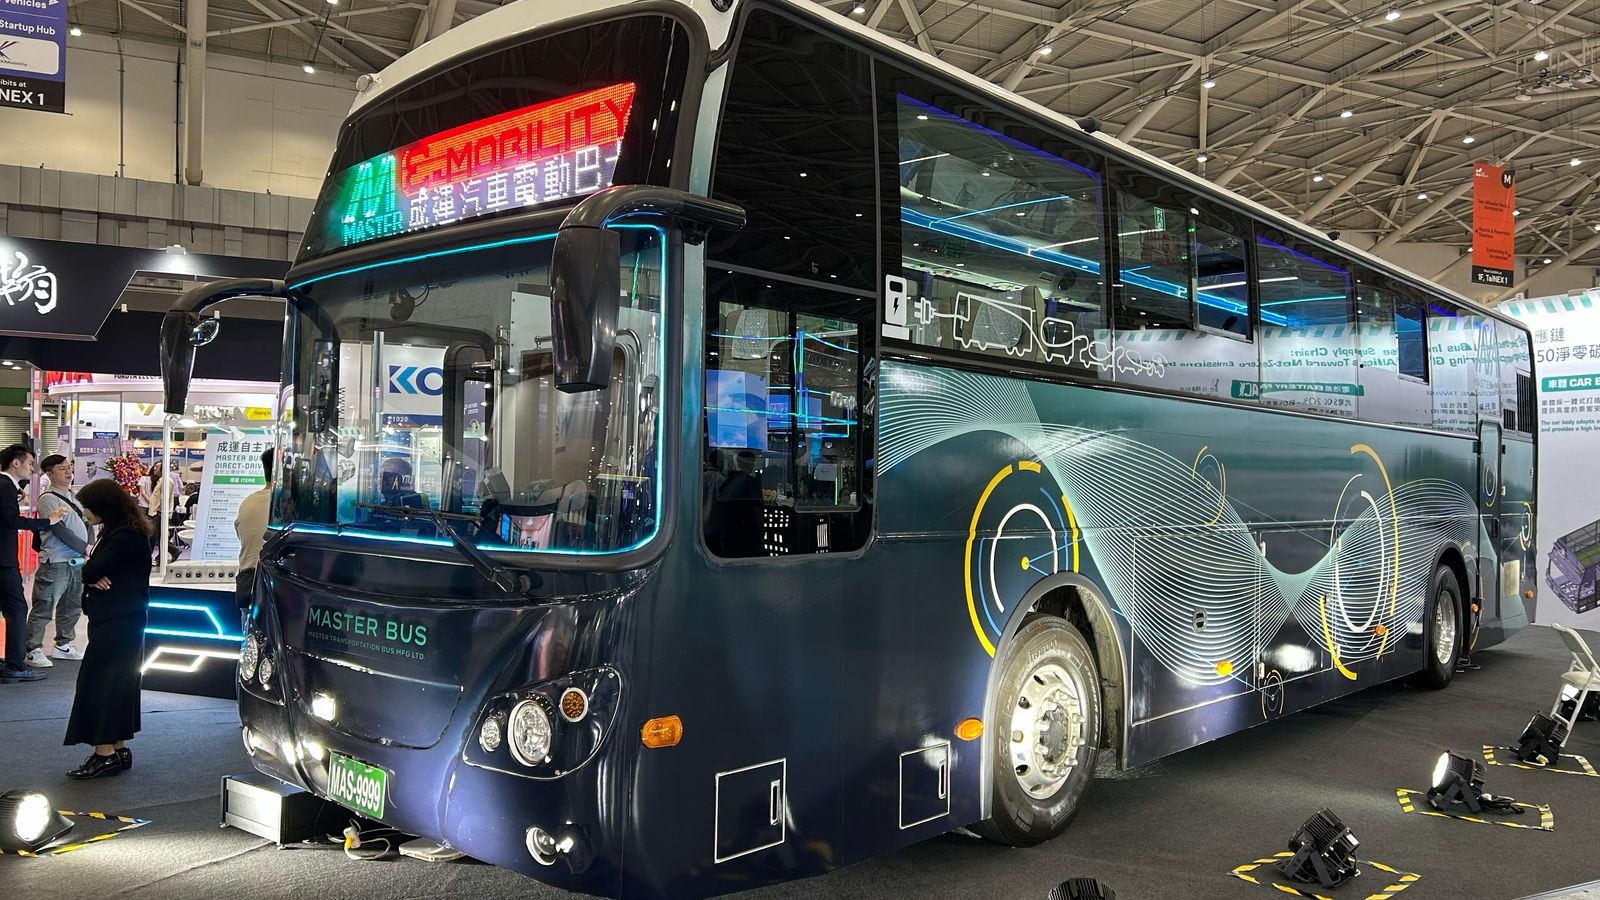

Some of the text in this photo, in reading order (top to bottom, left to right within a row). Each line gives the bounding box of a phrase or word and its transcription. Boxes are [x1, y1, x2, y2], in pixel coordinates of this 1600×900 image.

[0, 20, 56, 35] Startup Hub
[37, 93, 44, 106] 1
[1503, 174, 1512, 185] M
[343, 211, 404, 247] MASTER
[1569, 378, 1592, 387] CAR
[215, 454, 246, 462] MASTER
[308, 607, 427, 646] MASTER BUS
[308, 631, 424, 660] MASTER TRANSPORTATION BUS MFG LTD
[330, 764, 381, 812] MAS-9999
